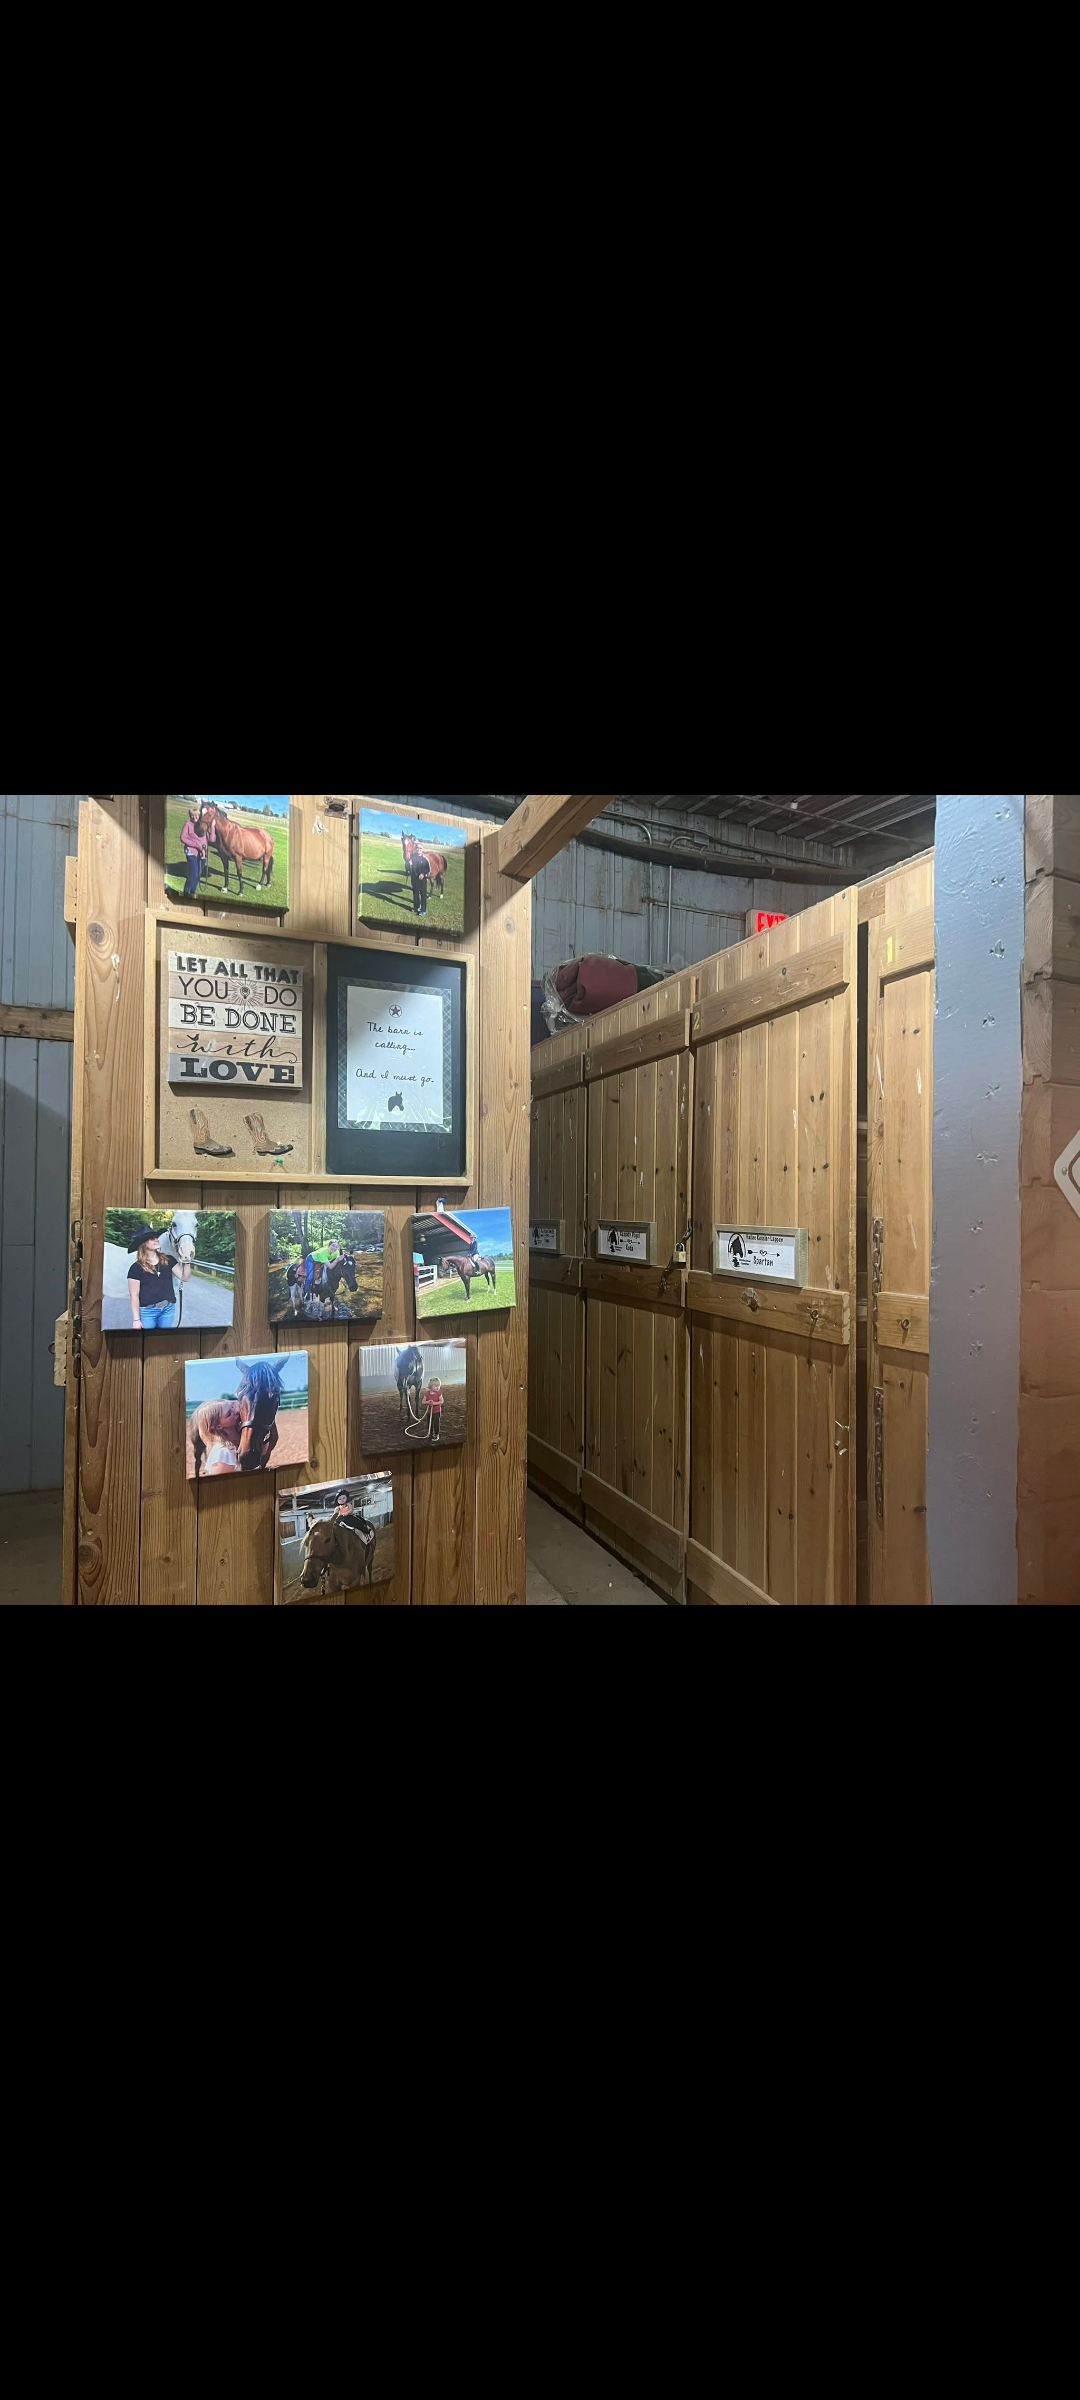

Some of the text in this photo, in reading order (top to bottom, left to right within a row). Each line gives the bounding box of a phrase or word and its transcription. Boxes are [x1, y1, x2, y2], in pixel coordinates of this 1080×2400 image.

[176, 955, 299, 984] LET ALL THAT
[178, 975, 297, 1007] YOU DO
[180, 1003, 296, 1034] BE DONE
[367, 1021, 384, 1033] The
[388, 1026, 411, 1035] barn
[176, 1034, 298, 1064] with
[180, 1057, 295, 1084] LOVE
[355, 1068, 434, 1087] And I must go.
[753, 1255, 774, 1267] Spartan
